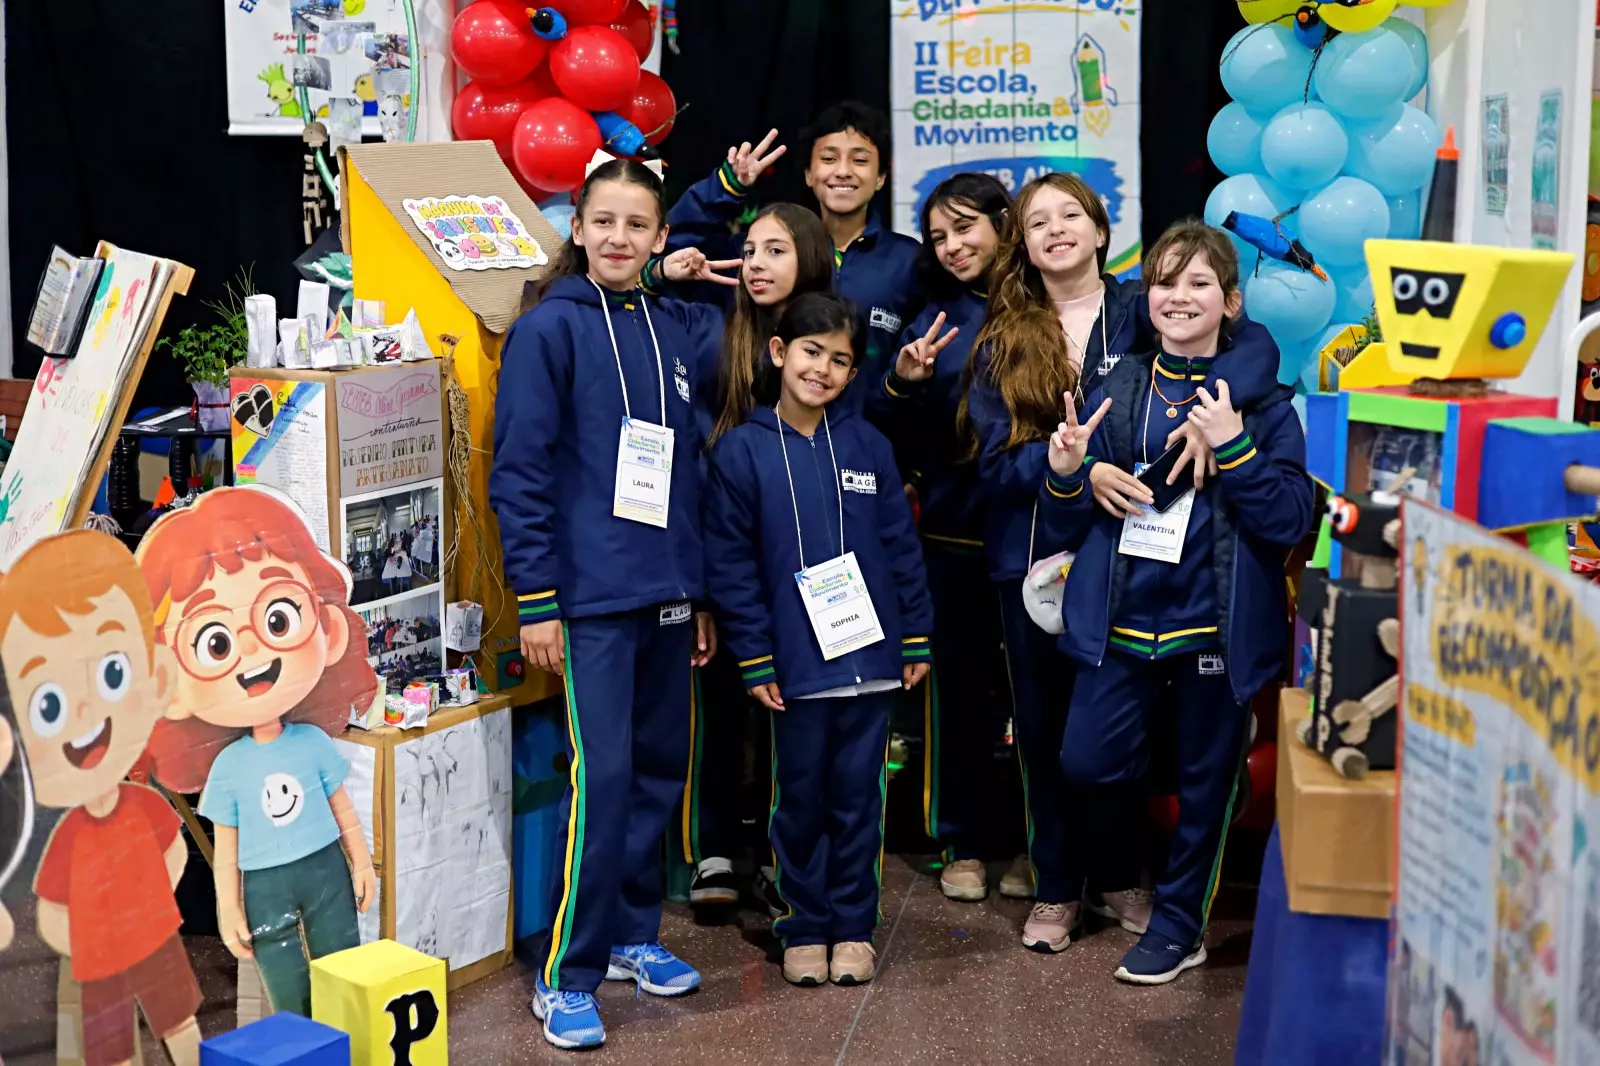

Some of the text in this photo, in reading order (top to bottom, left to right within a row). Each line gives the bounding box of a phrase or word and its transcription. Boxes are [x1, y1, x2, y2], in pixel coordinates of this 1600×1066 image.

[914, 37, 1031, 68] II Feira
[914, 69, 1037, 96] Escola,
[912, 98, 1051, 121] Cidadania
[914, 121, 1078, 146] Movimento
[417, 200, 503, 220] MÁQUINA DE
[426, 216, 518, 239] SQUISHIES
[392, 434, 436, 458] PINTURA
[632, 479, 655, 490] LAURA
[830, 613, 860, 629] SOPHIA
[384, 990, 439, 1066] P
